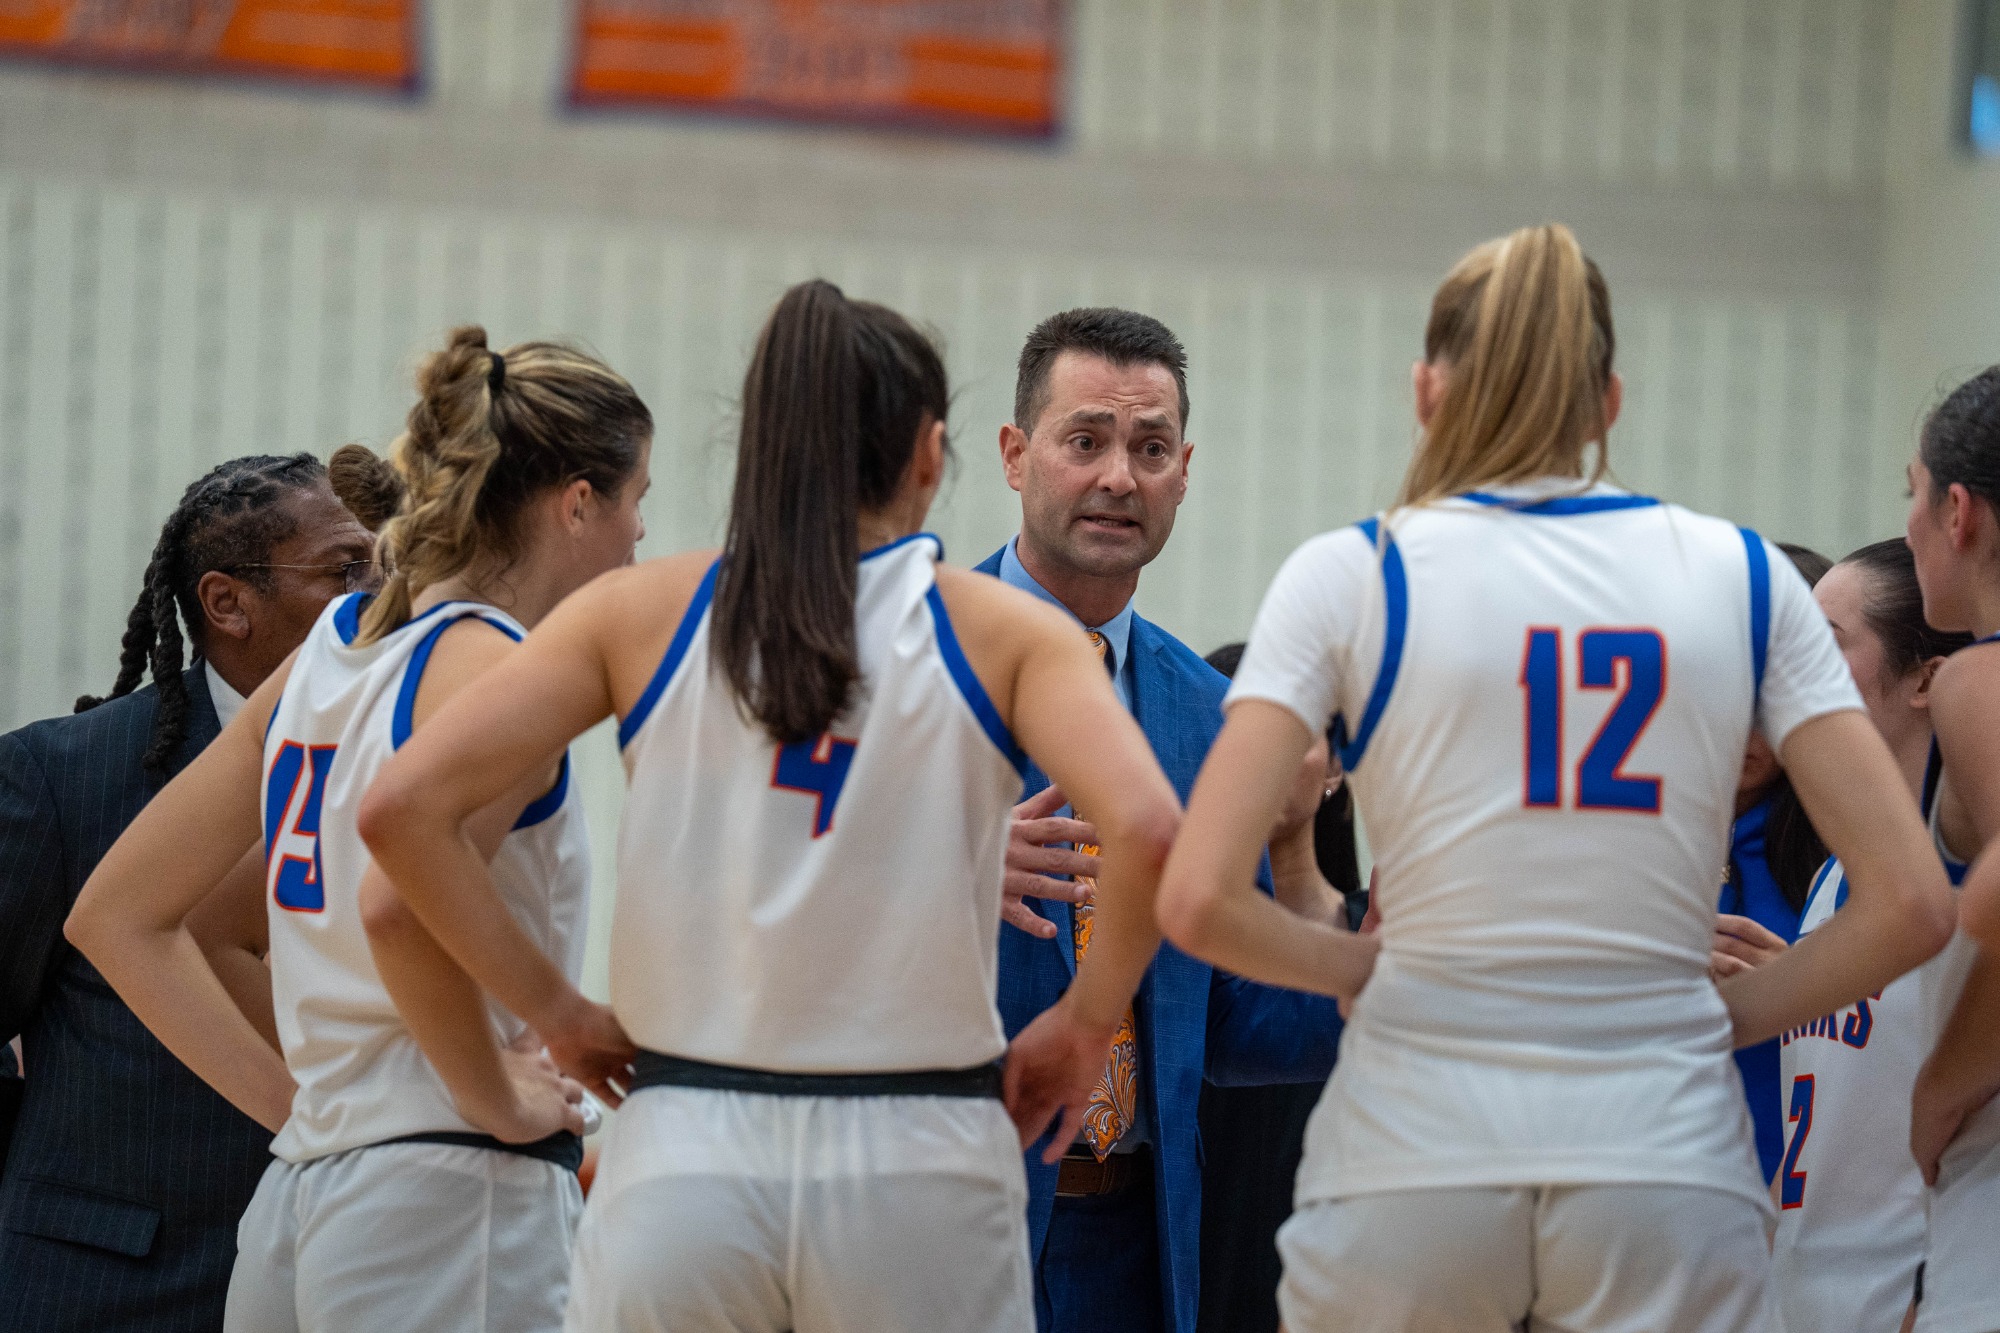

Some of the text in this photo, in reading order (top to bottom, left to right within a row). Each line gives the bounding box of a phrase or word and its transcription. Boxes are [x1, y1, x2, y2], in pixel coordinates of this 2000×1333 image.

[769, 732, 859, 839] 4
[1518, 625, 1668, 814] 12
[1781, 1073, 1815, 1210] 2
